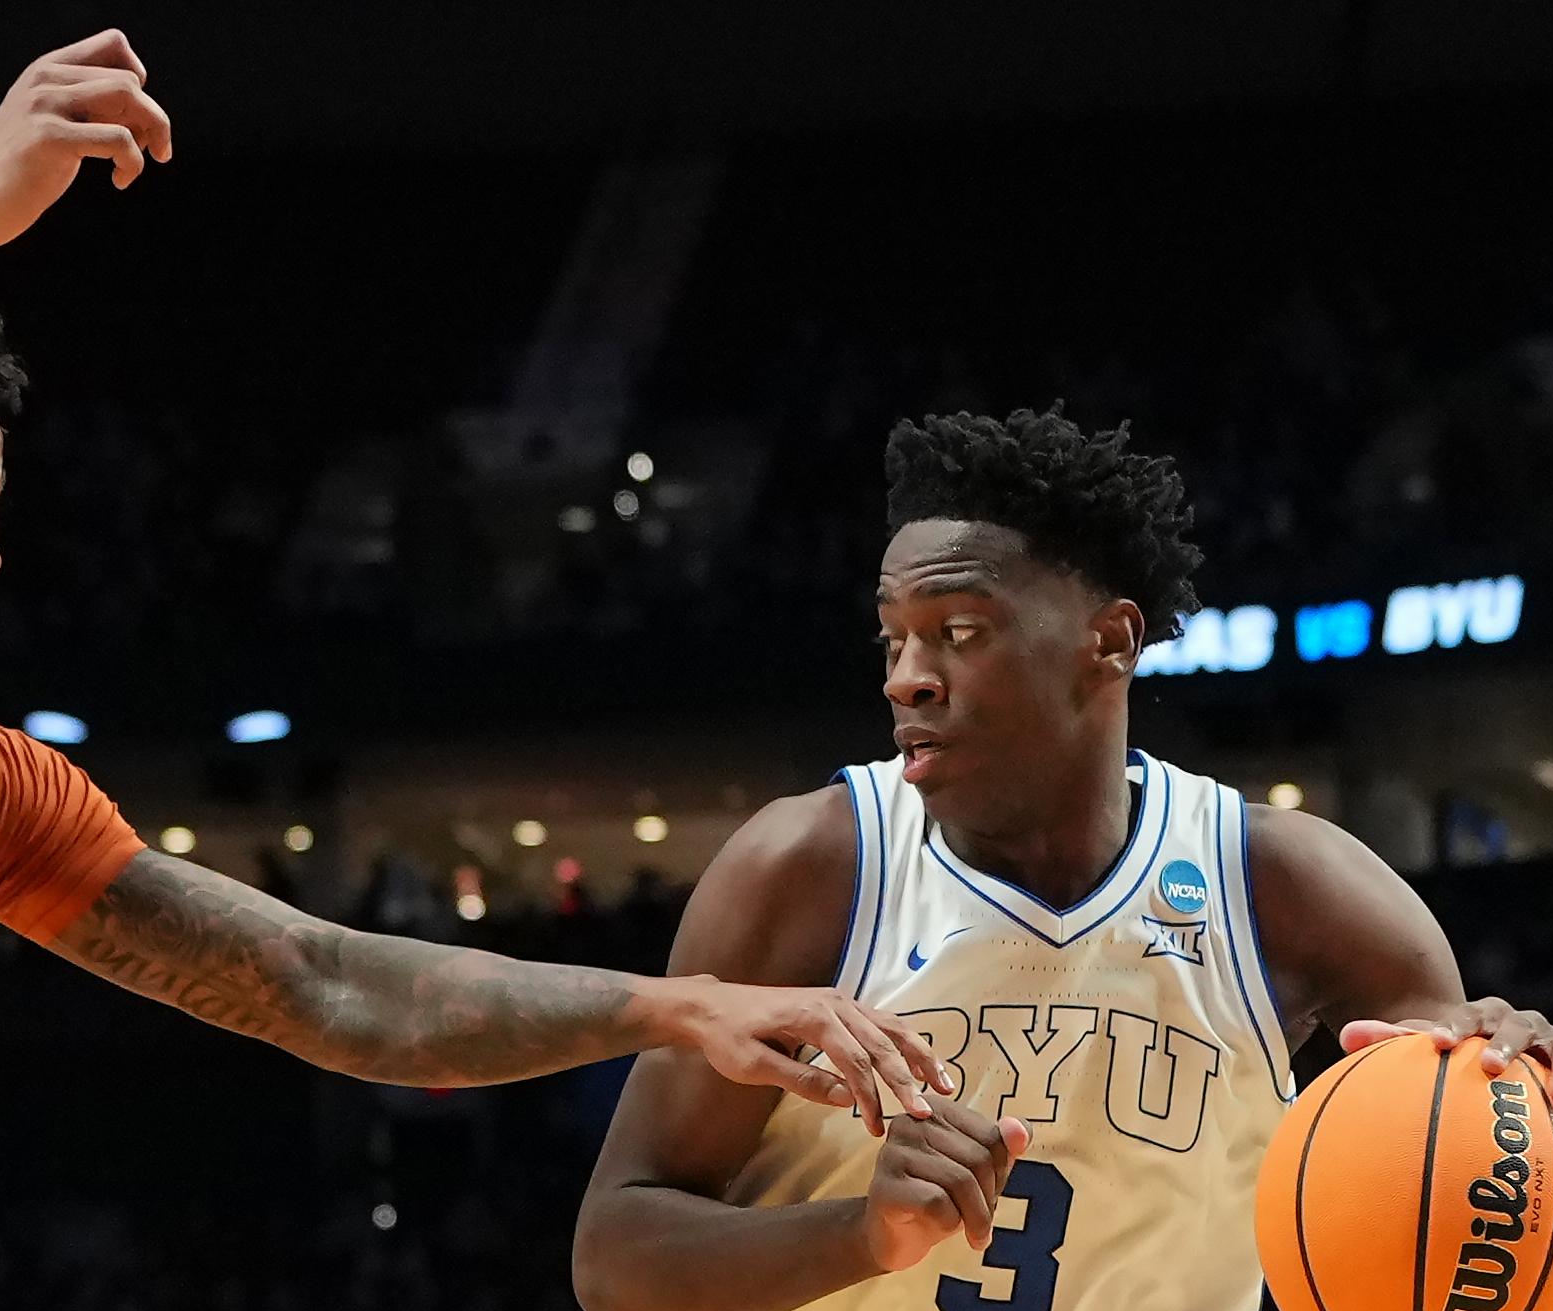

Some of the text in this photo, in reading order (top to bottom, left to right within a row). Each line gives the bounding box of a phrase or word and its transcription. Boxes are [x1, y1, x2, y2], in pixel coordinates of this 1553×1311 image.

[1382, 574, 1524, 655] BYU
[1167, 882, 1206, 901] NCAA
[853, 1004, 1220, 1152] BYU
[1530, 1157, 1546, 1234] EVO NXT
